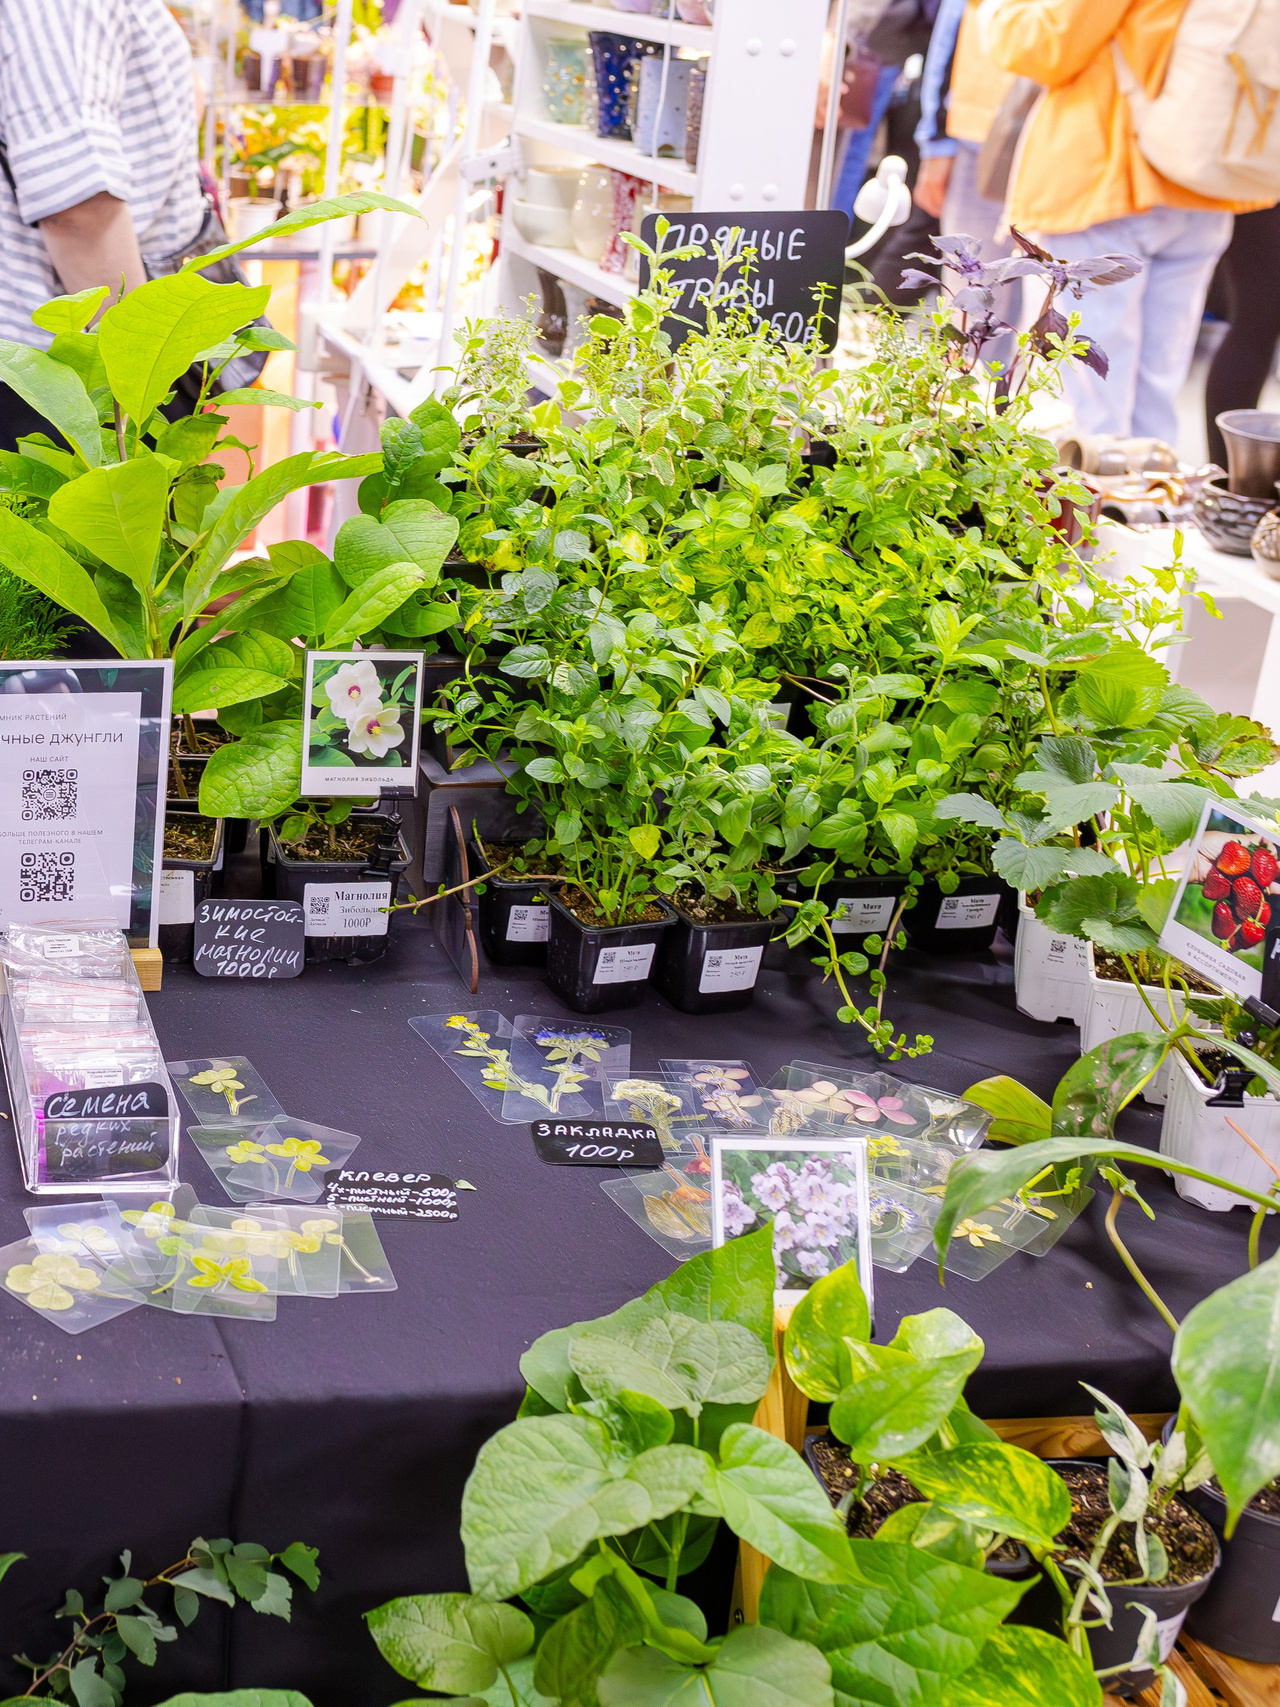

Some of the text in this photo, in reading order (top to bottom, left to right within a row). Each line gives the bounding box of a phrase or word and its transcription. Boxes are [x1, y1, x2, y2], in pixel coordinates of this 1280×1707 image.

[24, 712, 67, 721] РАСТЕНИЙ
[49, 732, 123, 747] джунгли
[49, 755, 69, 763] САЙТ
[334, 891, 388, 901] Магнолия
[48, 1092, 149, 1119] Семена
[537, 1123, 657, 1140] ЗАКЛАДКА
